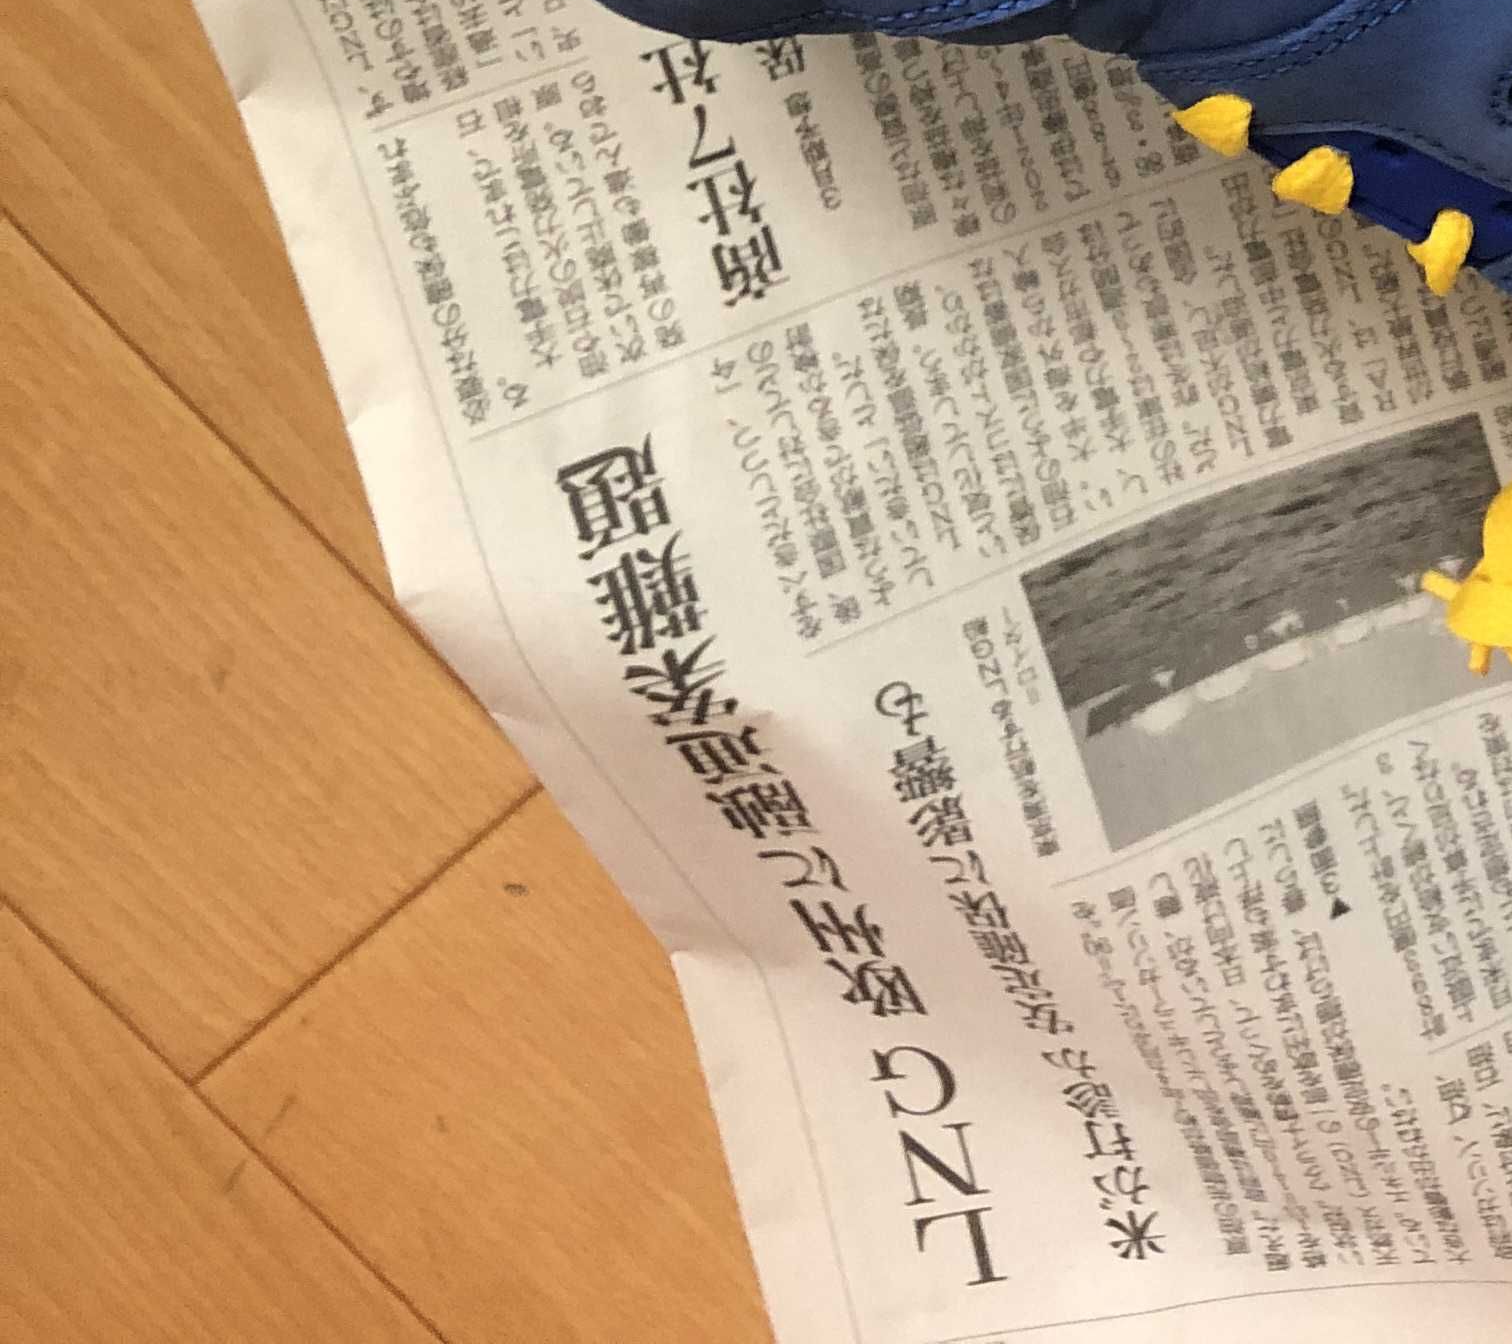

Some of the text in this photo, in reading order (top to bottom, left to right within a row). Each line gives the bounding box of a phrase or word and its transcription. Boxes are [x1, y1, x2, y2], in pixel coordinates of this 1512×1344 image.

[638, 33, 791, 308] 商社7社
[867, 1028, 1009, 1300] LNG
[1035, 1038, 1169, 1266] 米が打診か
